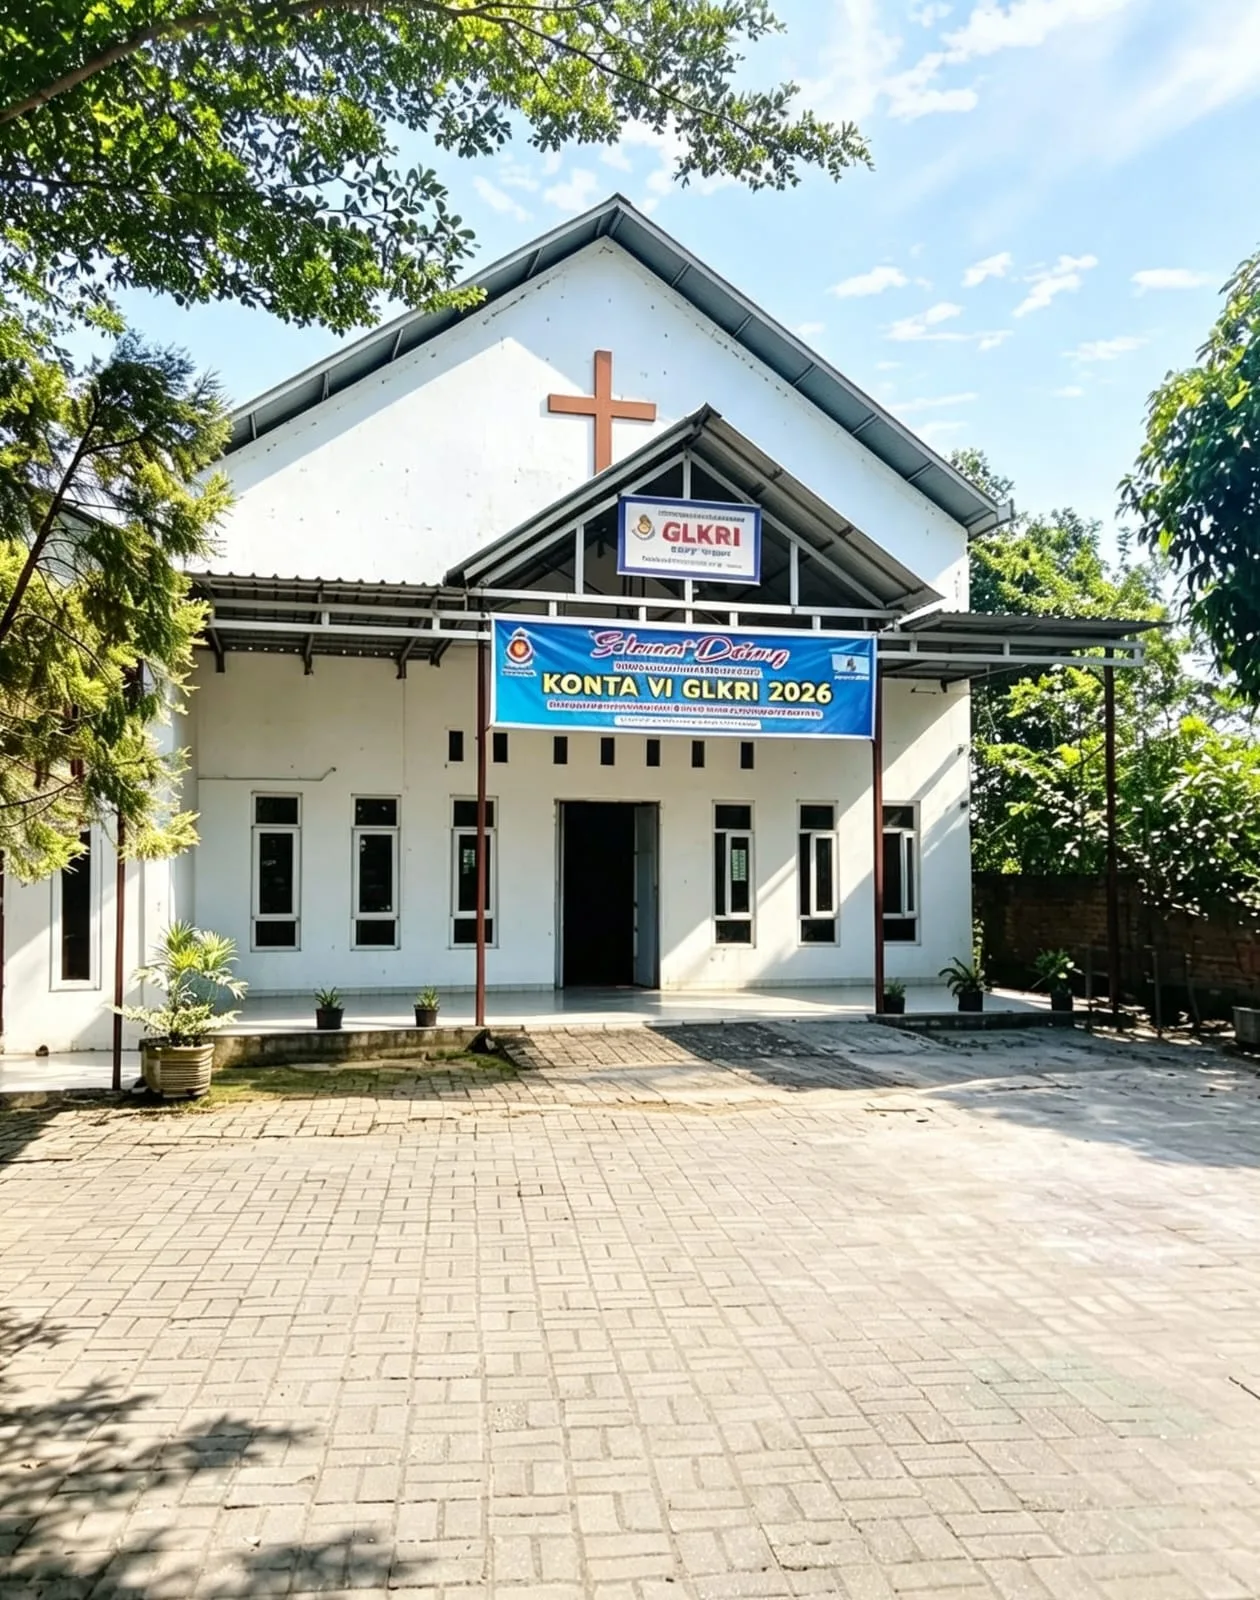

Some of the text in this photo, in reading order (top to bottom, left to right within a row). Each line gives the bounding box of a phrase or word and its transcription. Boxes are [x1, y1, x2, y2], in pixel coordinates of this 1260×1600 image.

[662, 521, 741, 547] GLKRI
[543, 672, 833, 705] KONTA VI GLKRI 2026
